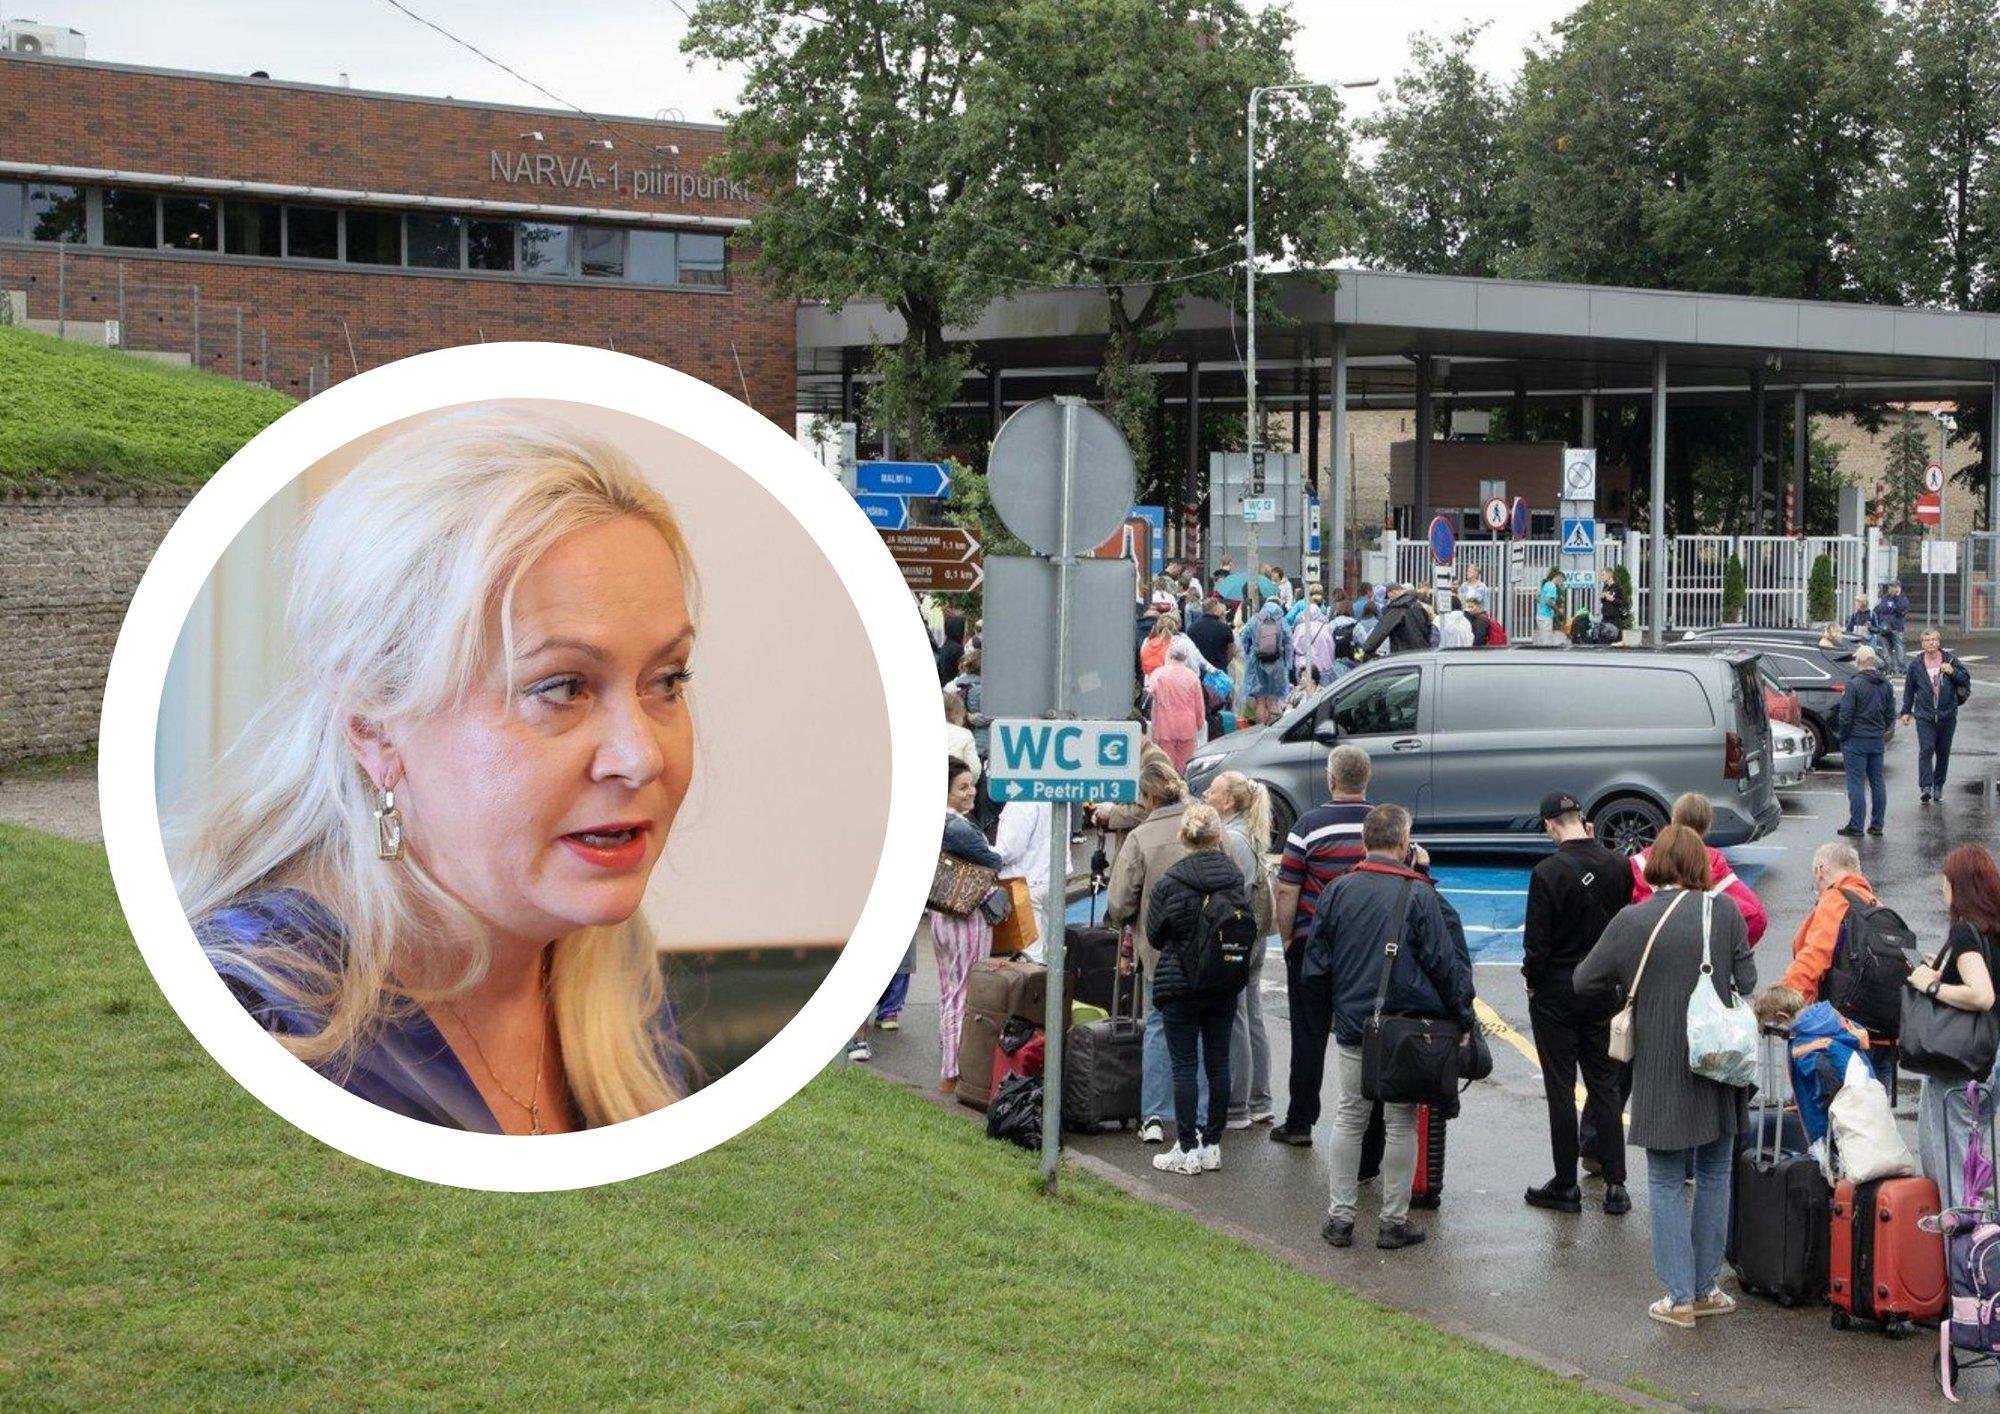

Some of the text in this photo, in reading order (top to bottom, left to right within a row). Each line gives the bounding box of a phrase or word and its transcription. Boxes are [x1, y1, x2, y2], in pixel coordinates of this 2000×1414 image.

[491, 150, 619, 191] NARVA-1
[1000, 726, 1082, 770] WC
[1034, 782, 1120, 801] Peetri pl 3
